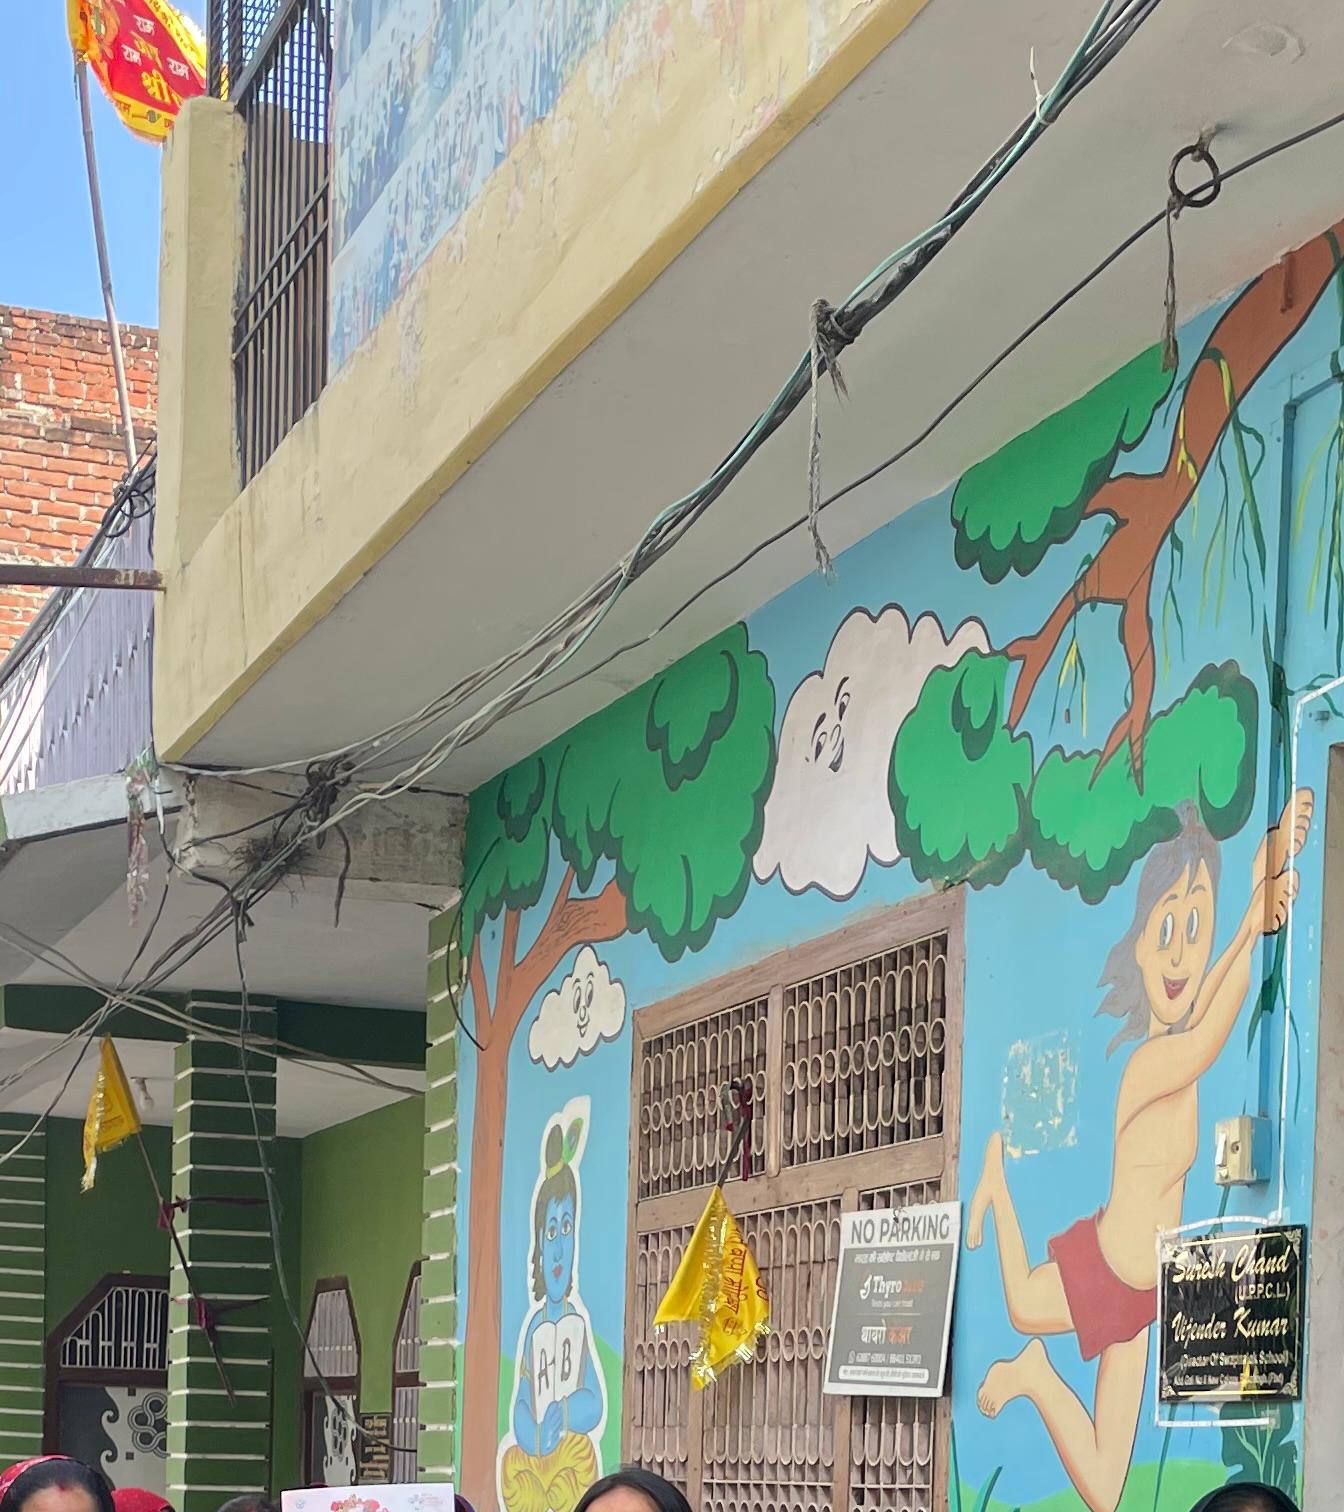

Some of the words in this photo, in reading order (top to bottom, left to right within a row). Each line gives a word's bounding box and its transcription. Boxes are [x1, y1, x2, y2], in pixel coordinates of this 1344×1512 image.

[851, 1218, 875, 1244] NO
[879, 1213, 949, 1242] PARKING
[1172, 1249, 1227, 1283] Suresh
[1231, 1244, 1291, 1282] Chand
[1171, 1311, 1227, 1349] Vijender
[1233, 1306, 1288, 1339] Kumar
[538, 1348, 549, 1396] A
[561, 1337, 571, 1382] B
